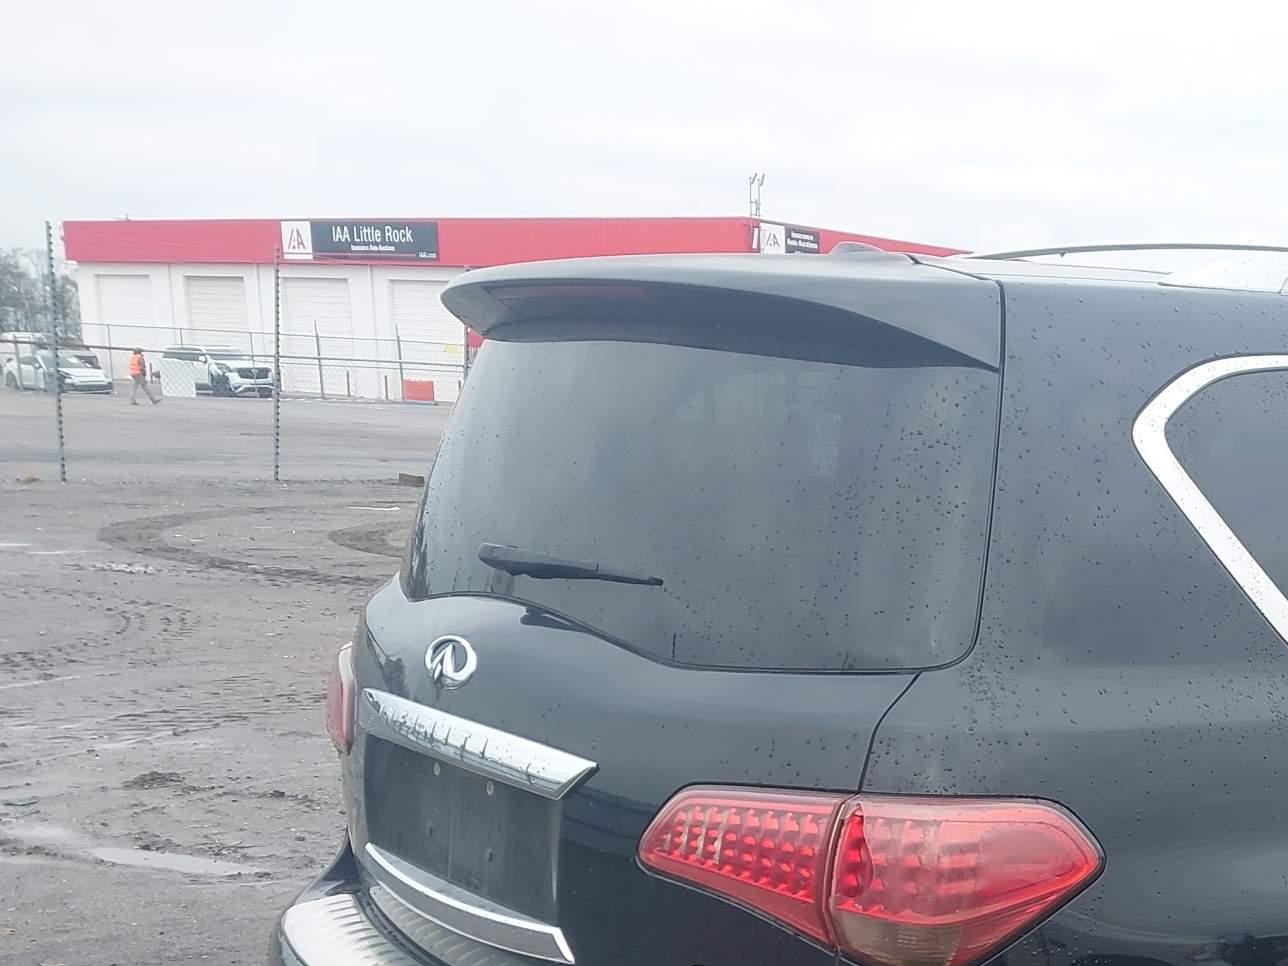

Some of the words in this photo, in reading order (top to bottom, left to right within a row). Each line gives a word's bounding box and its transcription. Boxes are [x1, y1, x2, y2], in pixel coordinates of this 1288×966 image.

[332, 225, 351, 242] IAA
[353, 225, 382, 242] Little
[385, 226, 414, 243] Rock
